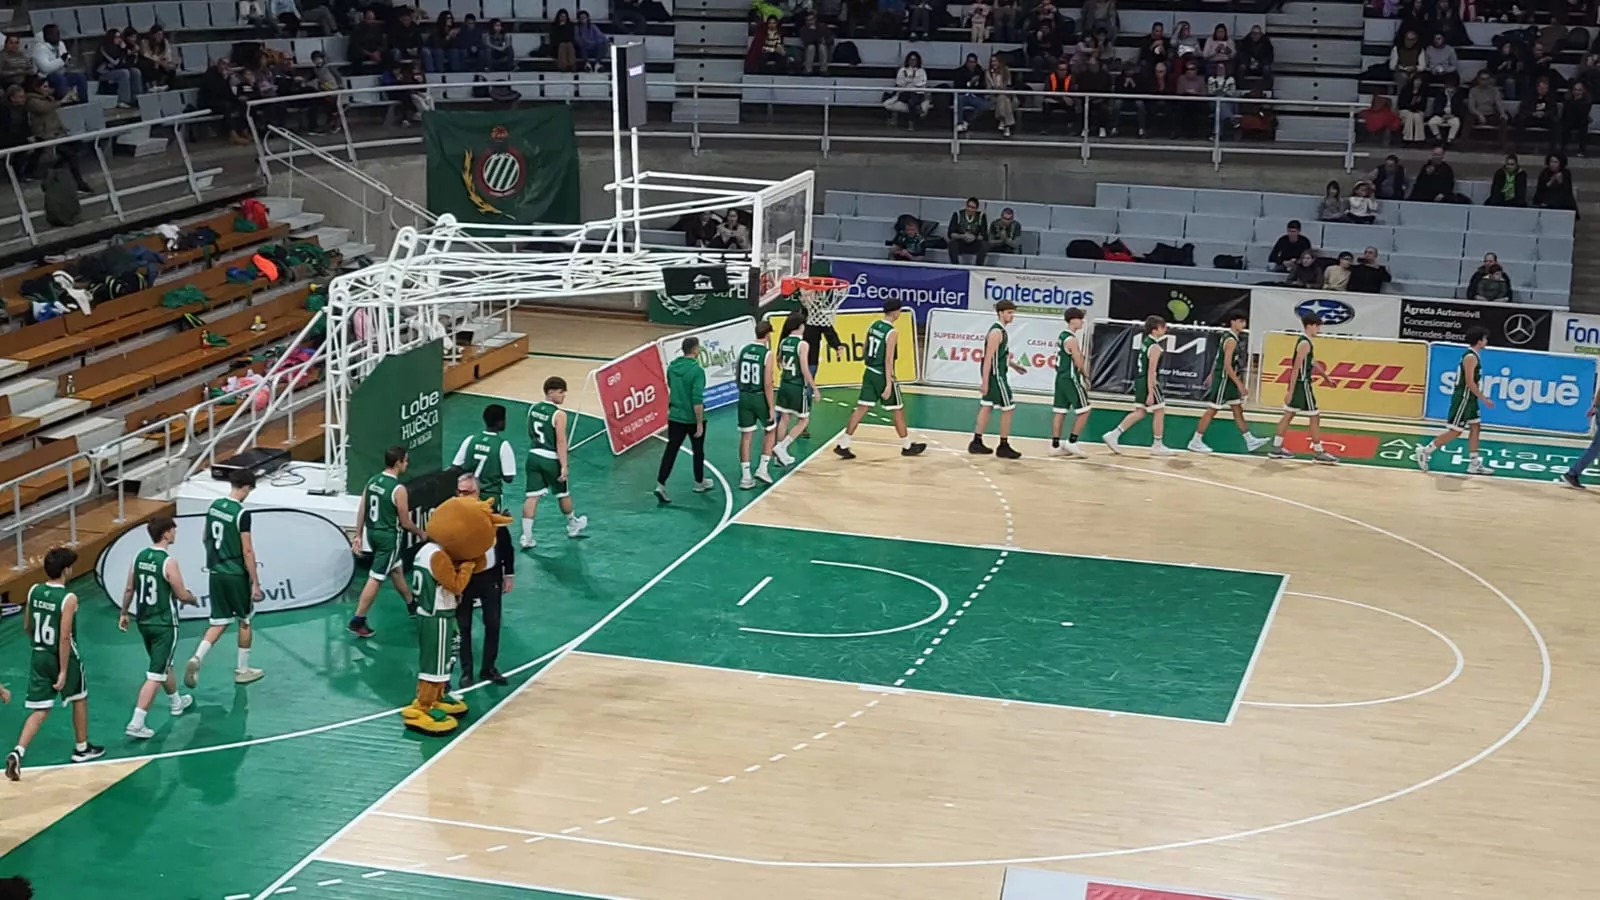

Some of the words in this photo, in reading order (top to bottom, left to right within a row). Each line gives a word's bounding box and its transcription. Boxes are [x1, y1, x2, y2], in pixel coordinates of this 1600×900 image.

[866, 286, 965, 306] ecomputer
[984, 277, 1094, 306] Fontecabras
[1403, 316, 1462, 329] Concesionario
[1404, 303, 1435, 315] Ágreda
[1436, 307, 1481, 319] Automóvil
[867, 335, 882, 358] 17
[1402, 327, 1467, 341] Mercedes-Benz
[740, 361, 760, 385] 88
[1275, 358, 1410, 393] DHL
[401, 391, 440, 420] Lobe
[613, 385, 656, 419] Lobe
[401, 409, 439, 441] Huesca
[533, 421, 545, 444] 5
[473, 453, 488, 478] 7
[369, 494, 379, 522] 8
[211, 520, 224, 550] 9
[138, 574, 158, 606] 13
[33, 611, 55, 646] 16
